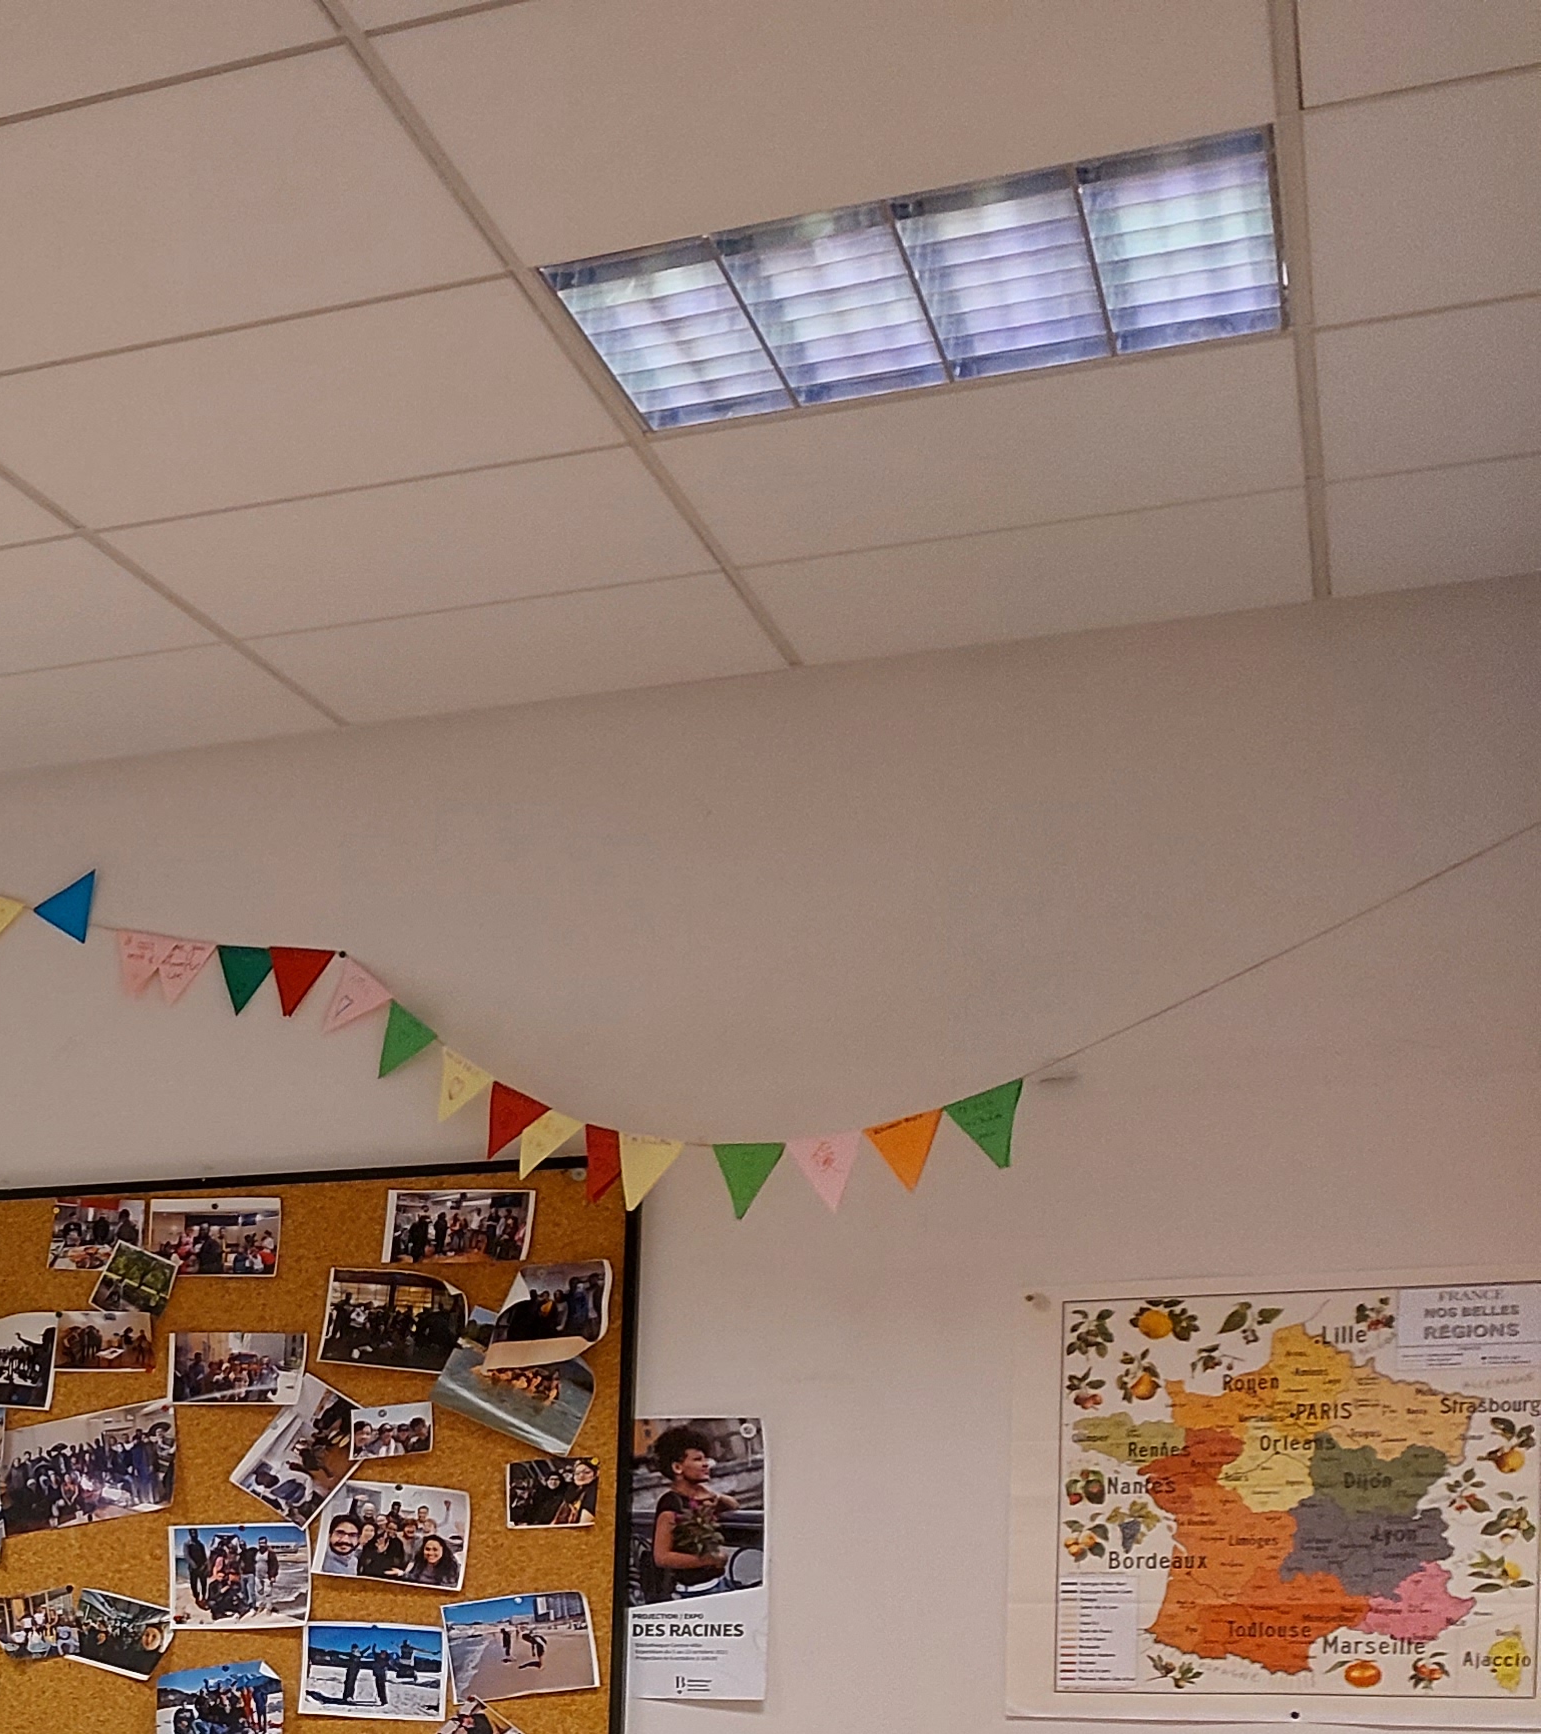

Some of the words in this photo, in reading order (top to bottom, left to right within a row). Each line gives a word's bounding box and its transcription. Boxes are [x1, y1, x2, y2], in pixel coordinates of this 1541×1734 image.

[1438, 1288, 1504, 1302] FRANCE
[1424, 1306, 1458, 1319] NOS
[1462, 1304, 1520, 1317] BELLES
[1321, 1325, 1367, 1345] Lille
[1222, 1374, 1280, 1395] Rouen
[1296, 1402, 1353, 1420] PARIS
[1440, 1396, 1541, 1417] Strasbourg
[1107, 1476, 1176, 1495] Nantes
[1343, 1472, 1393, 1490] Dijon
[1108, 1551, 1208, 1570] Bordeaux
[632, 1623, 666, 1637] DES
[669, 1623, 745, 1637] RACINES
[1463, 1651, 1531, 1670] Ajaccio
